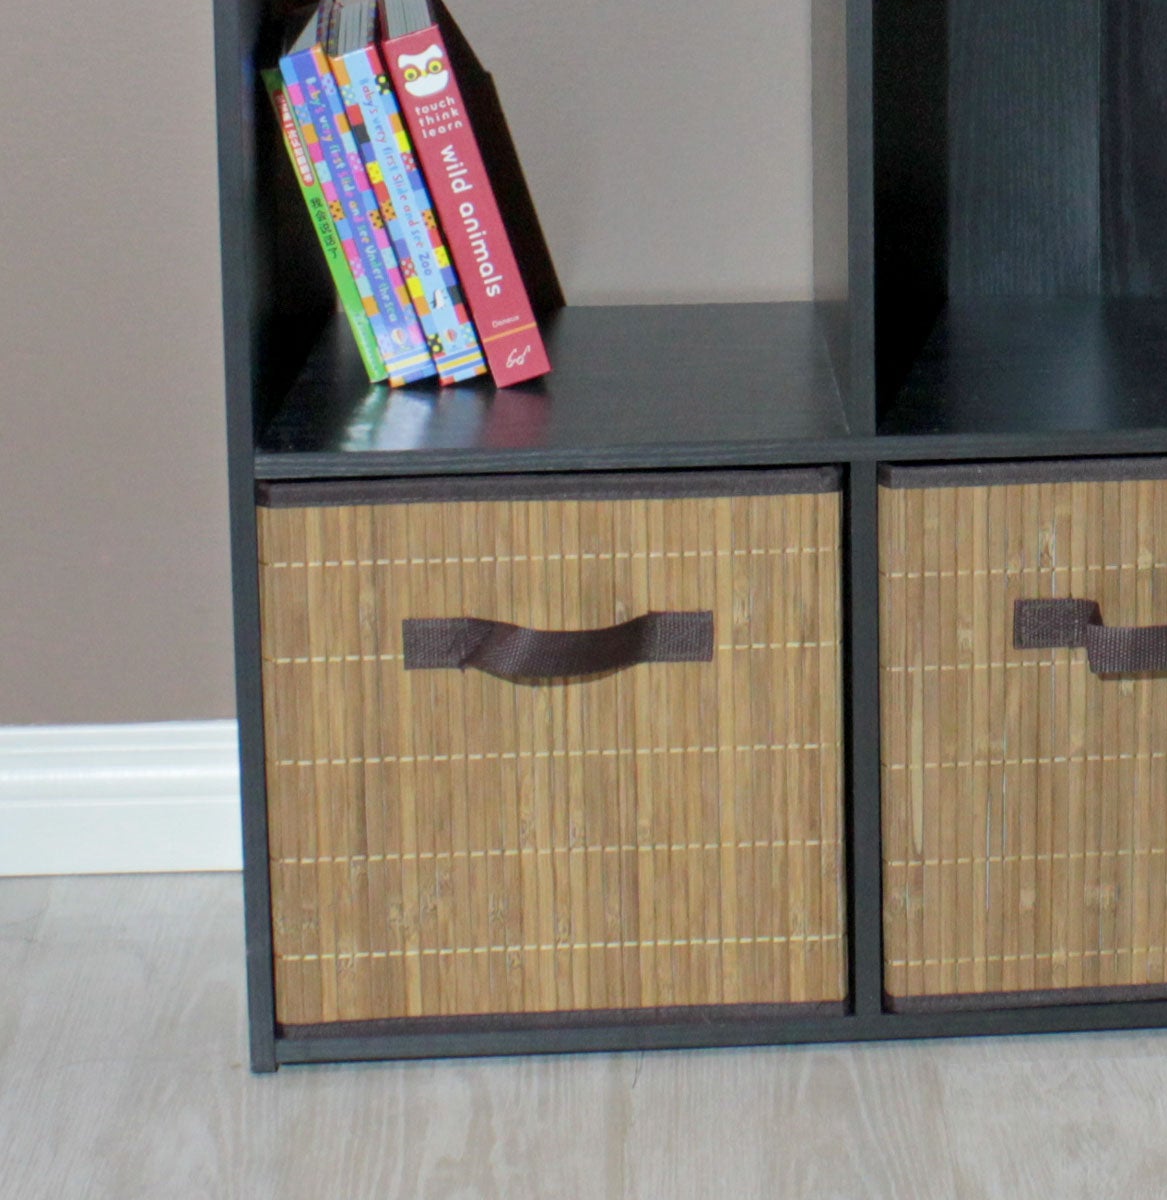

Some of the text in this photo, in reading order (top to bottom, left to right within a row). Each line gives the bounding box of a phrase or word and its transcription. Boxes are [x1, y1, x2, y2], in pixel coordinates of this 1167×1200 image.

[415, 96, 456, 116] touch
[418, 108, 459, 127] think
[422, 120, 463, 139] learn
[304, 76, 327, 115] Baby's
[319, 115, 334, 142] very
[329, 144, 347, 170] first
[348, 200, 365, 223] and
[357, 224, 371, 244] see
[364, 245, 385, 281] Under
[379, 281, 391, 301] the
[360, 78, 433, 277] Baby's very first Slide and see Zoo
[440, 144, 504, 298] wild animals
